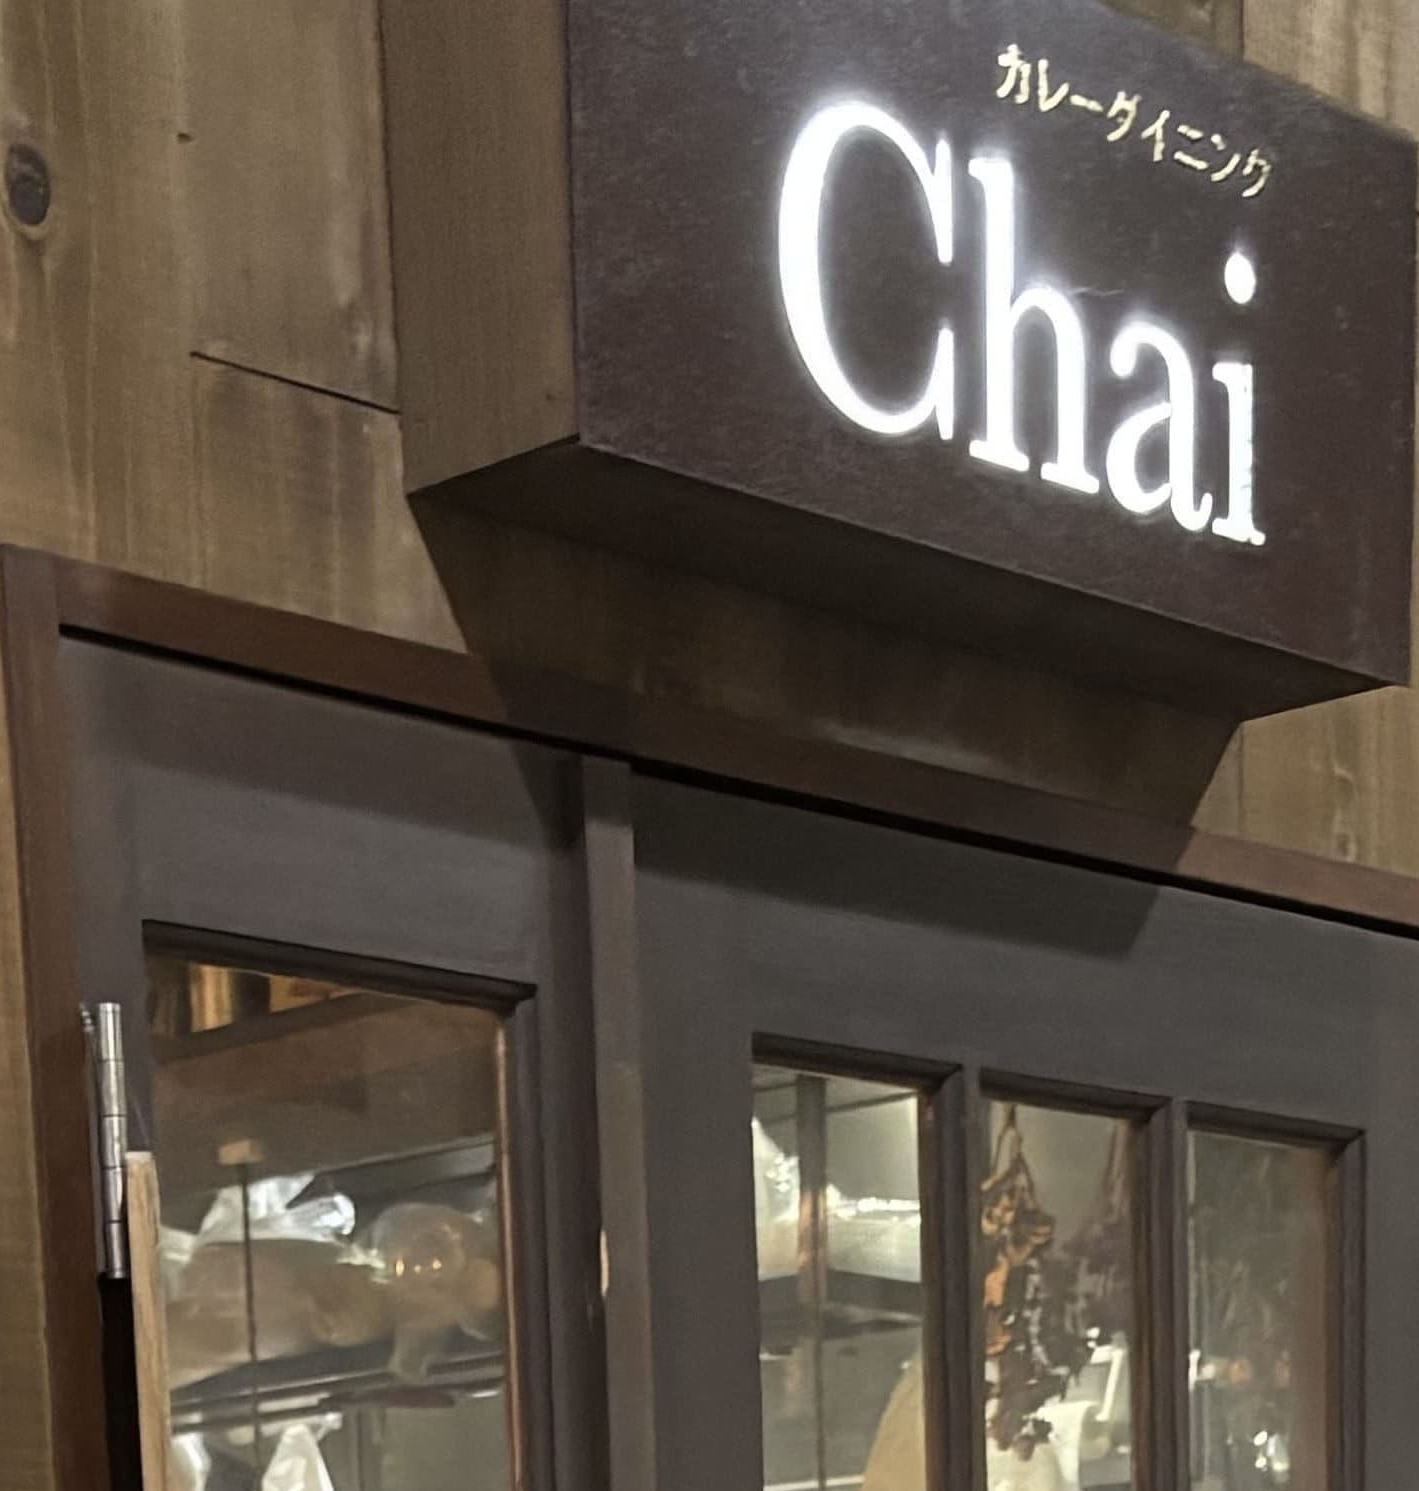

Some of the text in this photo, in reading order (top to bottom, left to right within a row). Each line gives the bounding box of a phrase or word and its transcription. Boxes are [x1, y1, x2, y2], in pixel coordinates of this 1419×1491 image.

[994, 42, 1274, 199] カレーダイニング
[777, 100, 1267, 546] Chai
